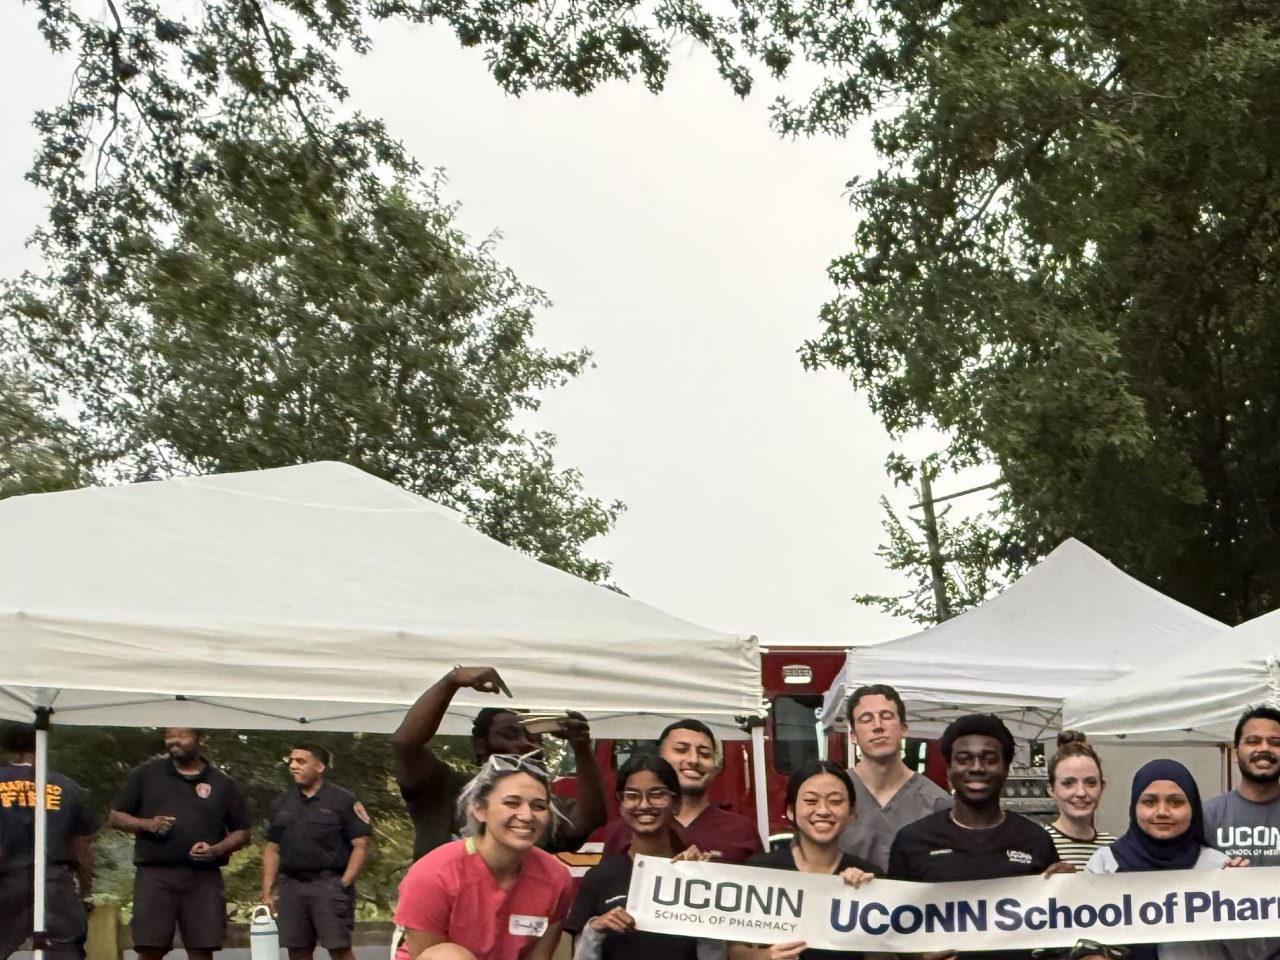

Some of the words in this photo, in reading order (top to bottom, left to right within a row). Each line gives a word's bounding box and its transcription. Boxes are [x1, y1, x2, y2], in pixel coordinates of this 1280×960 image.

[652, 875, 804, 918] UCONN
[830, 898, 988, 935] UCONN
[994, 893, 1133, 932] School
[1139, 891, 1179, 925] of
[654, 909, 704, 924] SCHOOL
[709, 915, 726, 925] OF
[729, 917, 798, 932] PHARMACY
